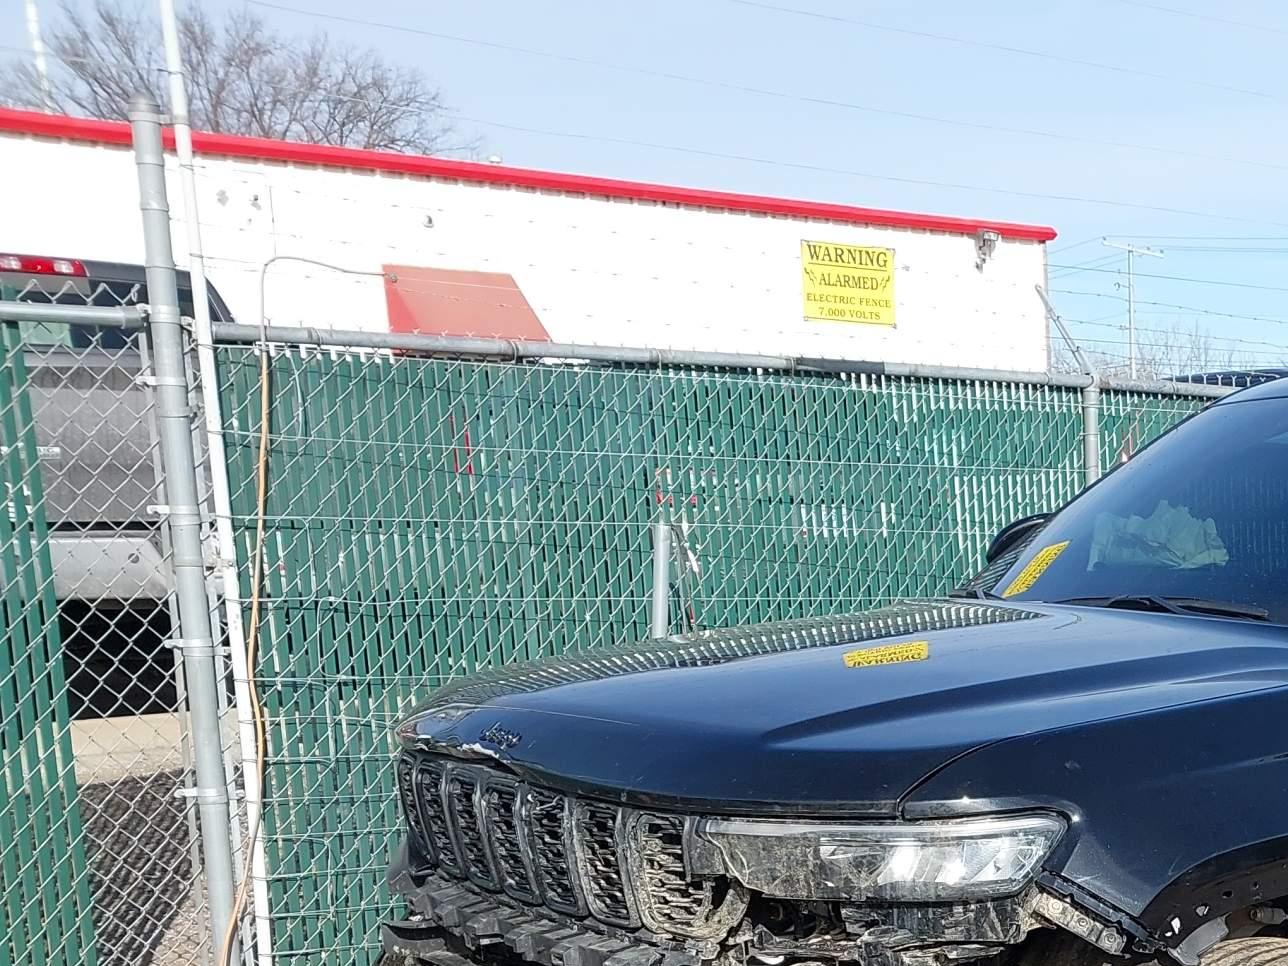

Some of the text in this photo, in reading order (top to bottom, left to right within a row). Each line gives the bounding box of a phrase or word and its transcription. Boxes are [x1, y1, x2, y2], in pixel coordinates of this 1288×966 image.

[807, 244, 888, 268] WARNING
[819, 272, 879, 291] ALARMED
[806, 292, 892, 308] ELECTRIC FENCE
[848, 309, 881, 320] VOLTS
